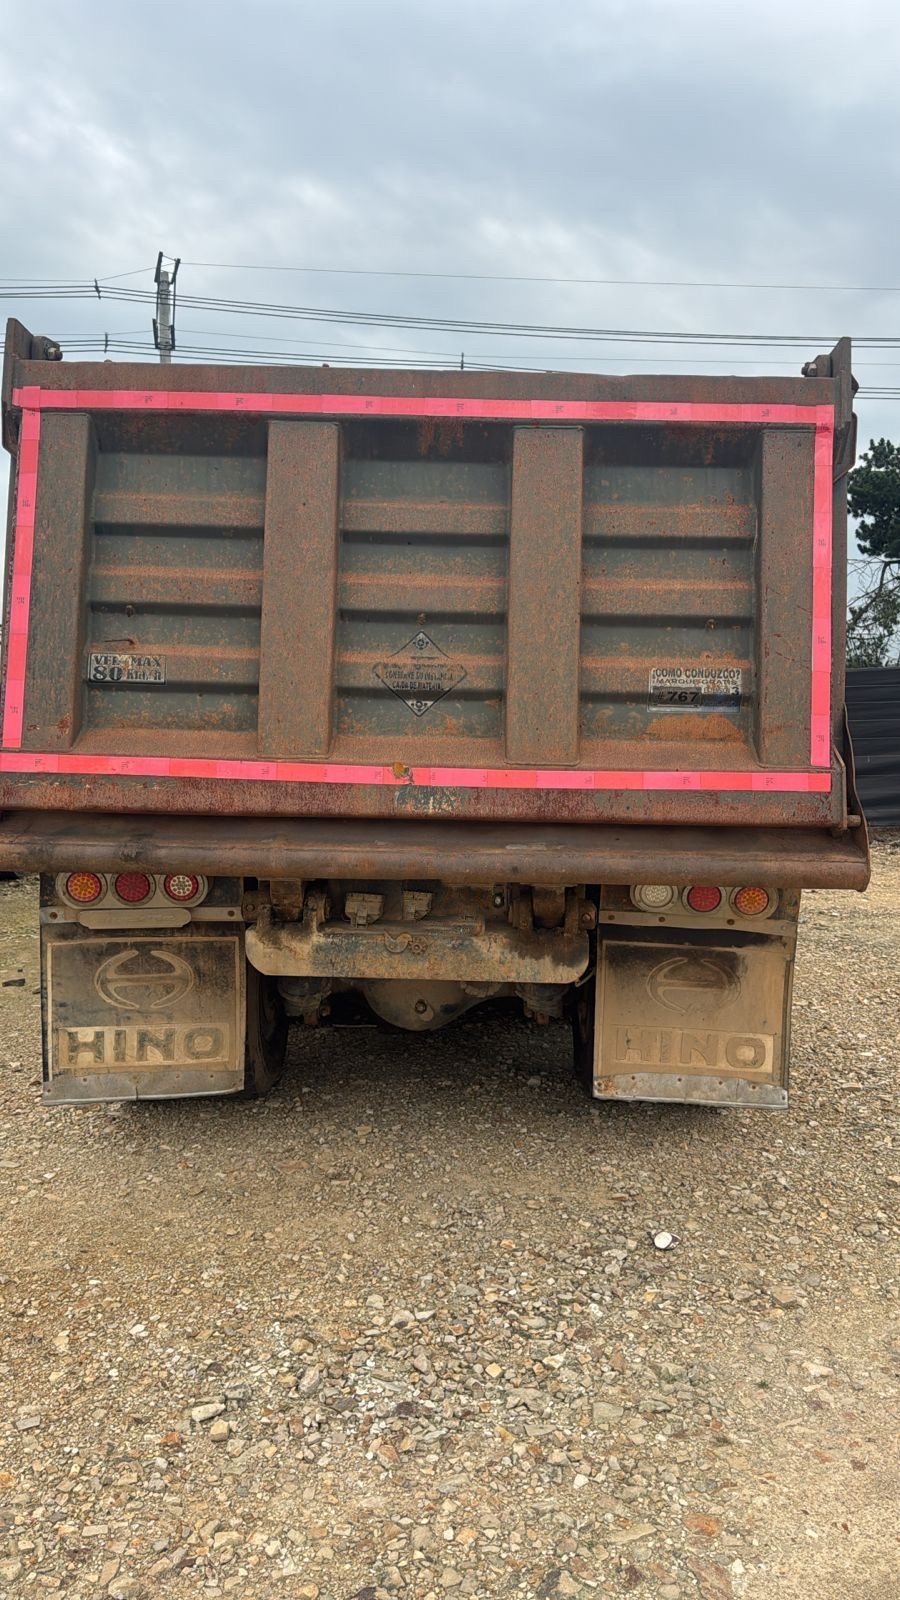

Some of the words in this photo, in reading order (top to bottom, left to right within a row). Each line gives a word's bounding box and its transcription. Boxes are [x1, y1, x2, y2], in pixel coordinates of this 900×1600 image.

[93, 666, 122, 681] 80
[67, 1027, 224, 1065] HINO
[615, 1027, 767, 1069] HINO
